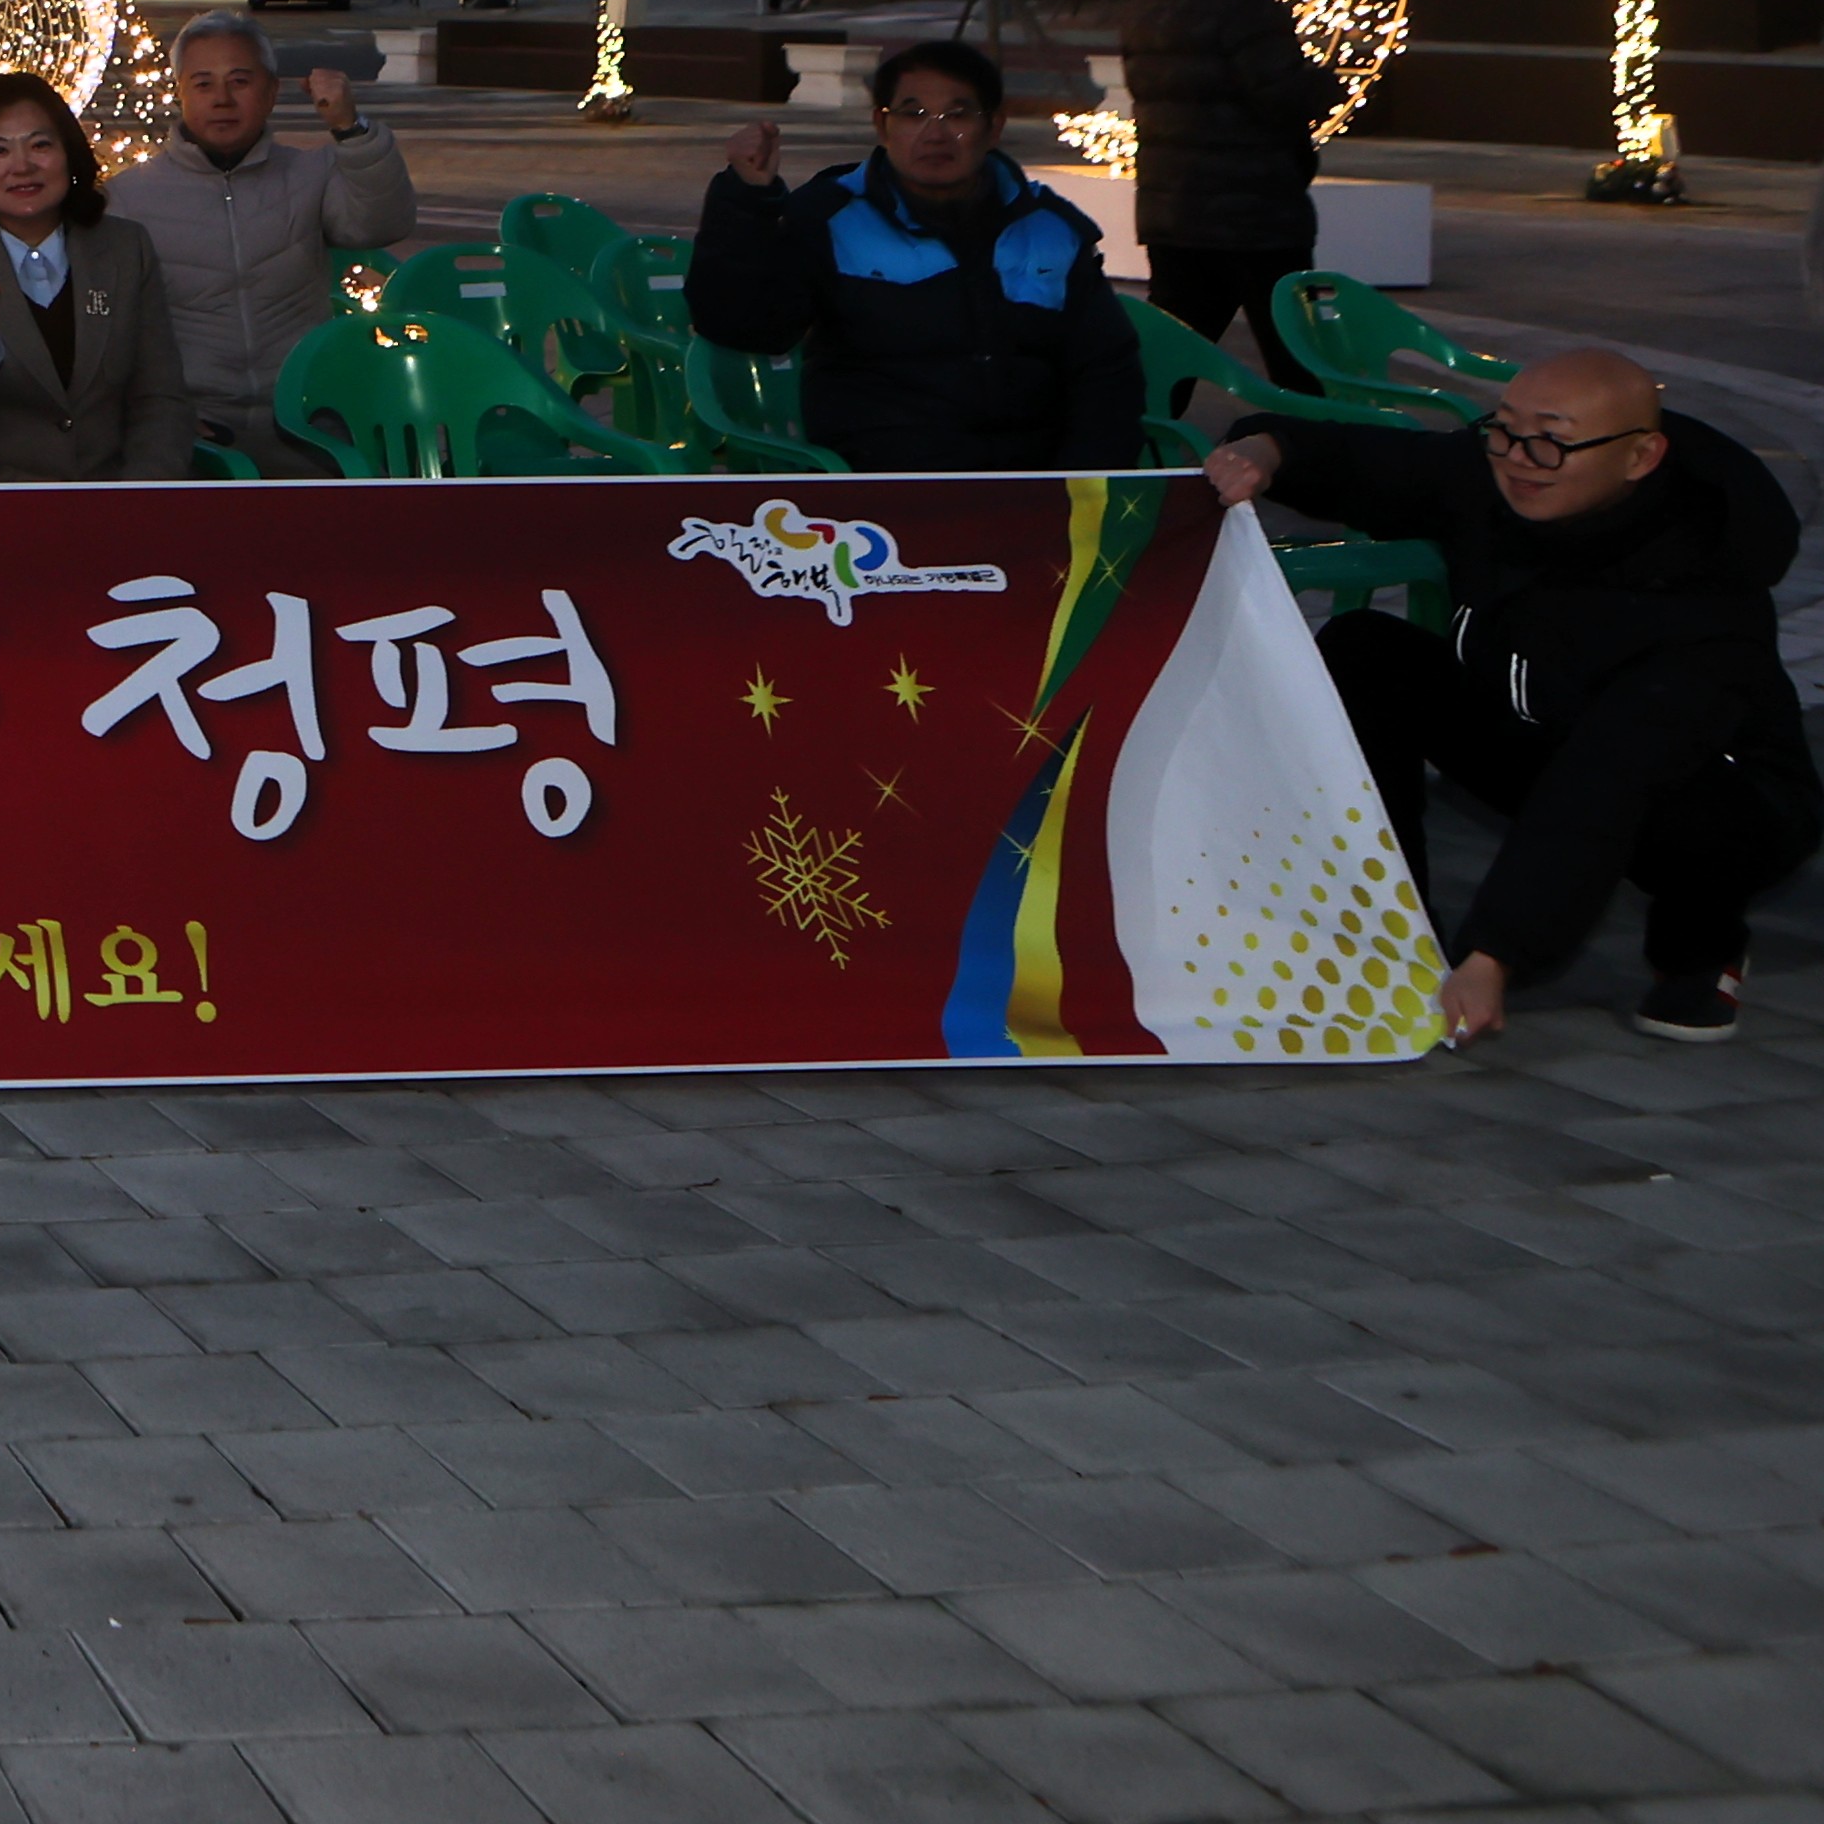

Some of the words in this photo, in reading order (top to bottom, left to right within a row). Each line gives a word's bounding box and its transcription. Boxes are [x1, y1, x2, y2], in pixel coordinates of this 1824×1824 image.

[760, 559, 843, 618] 행복
[863, 573, 924, 587] 하나되는
[925, 570, 999, 585] 가평특별군
[81, 575, 615, 840] 청평
